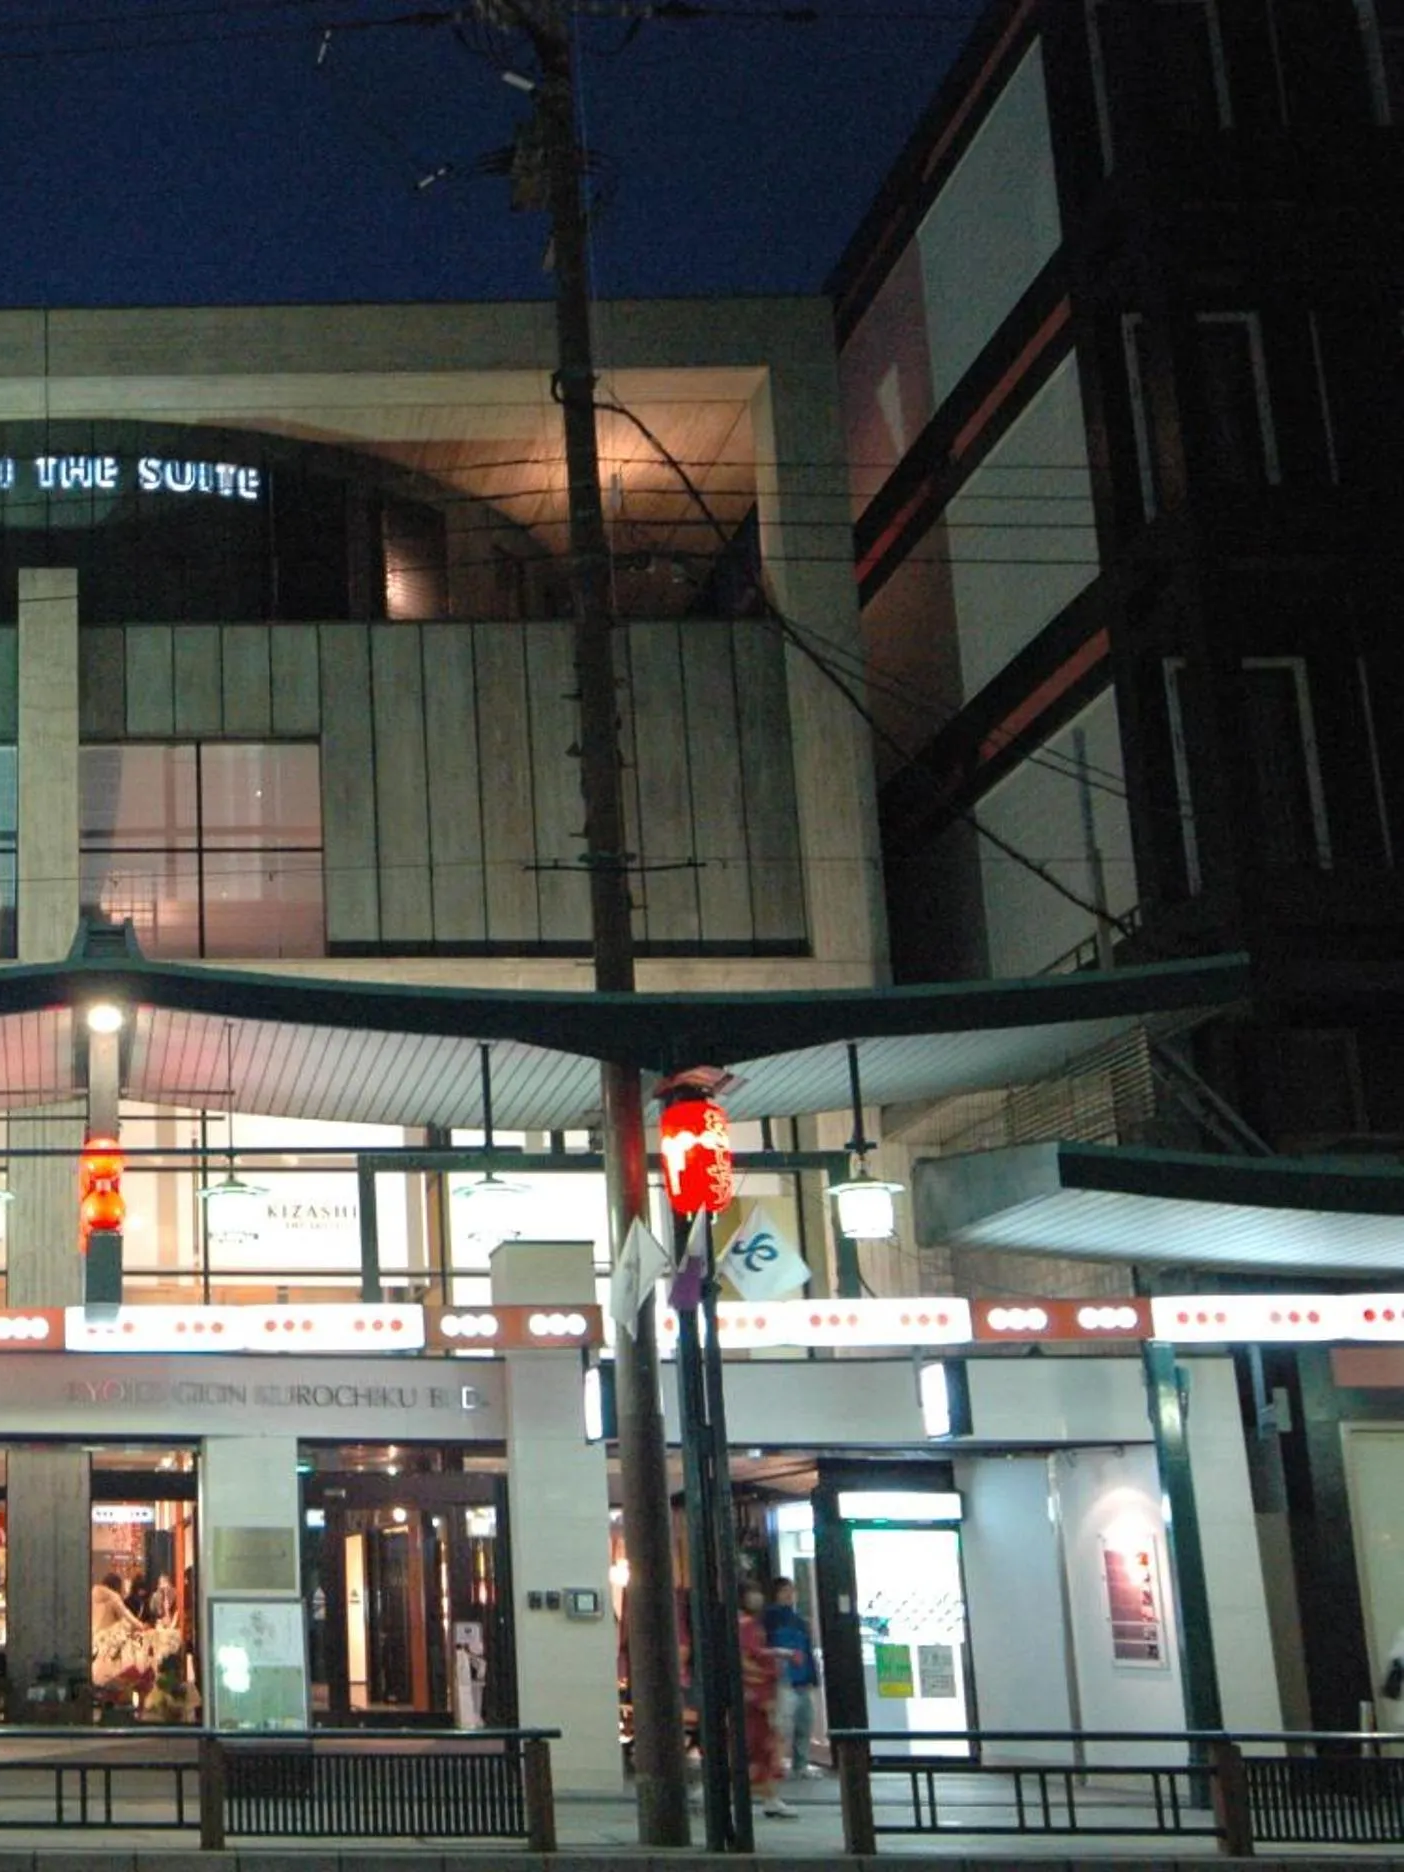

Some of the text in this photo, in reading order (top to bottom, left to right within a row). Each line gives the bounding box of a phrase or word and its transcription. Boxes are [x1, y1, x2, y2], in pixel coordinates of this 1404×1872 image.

[35, 457, 119, 488] THE
[138, 457, 261, 499] SUITE
[267, 1205, 356, 1219] KIZASHI
